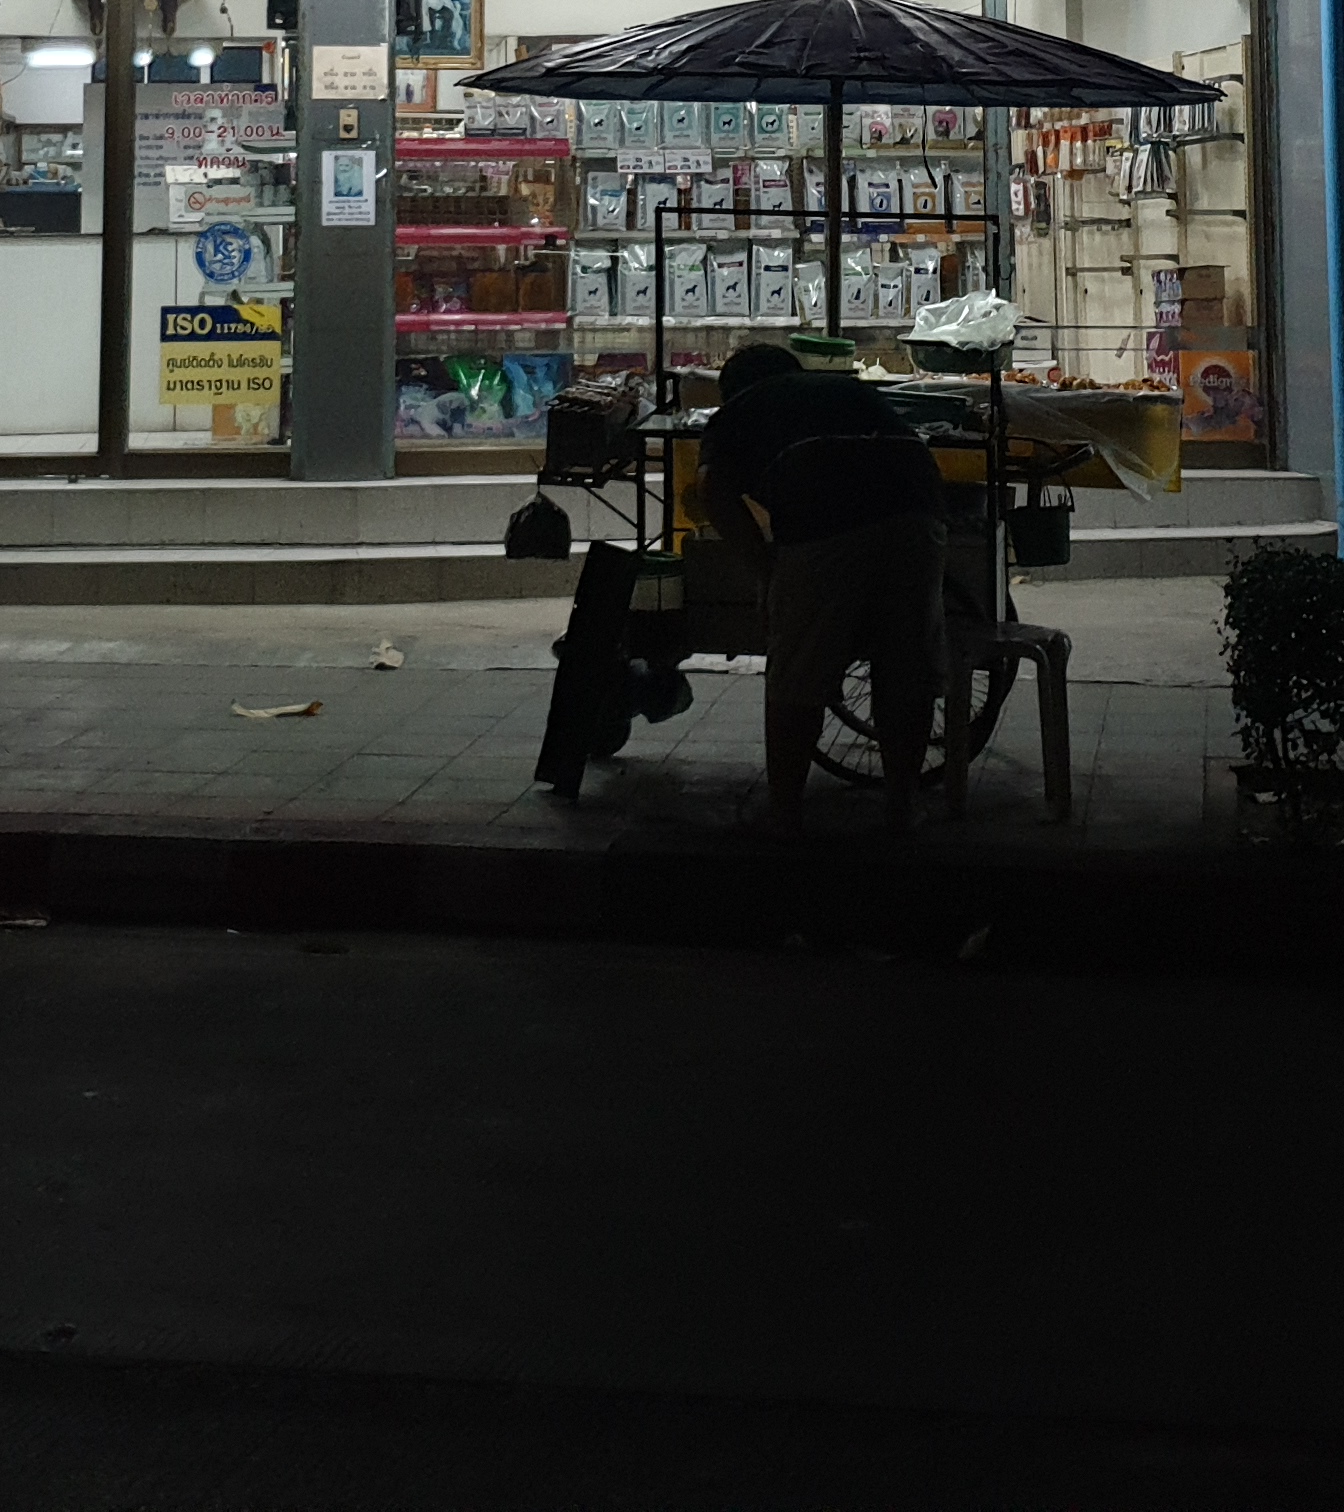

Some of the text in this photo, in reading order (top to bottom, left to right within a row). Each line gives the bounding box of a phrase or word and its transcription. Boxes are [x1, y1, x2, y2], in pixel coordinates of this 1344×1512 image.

[172, 85, 277, 107] เวลาทำการ
[166, 314, 213, 336] ISO
[247, 377, 273, 391] ISO
[1189, 373, 1248, 388] Pedigr
